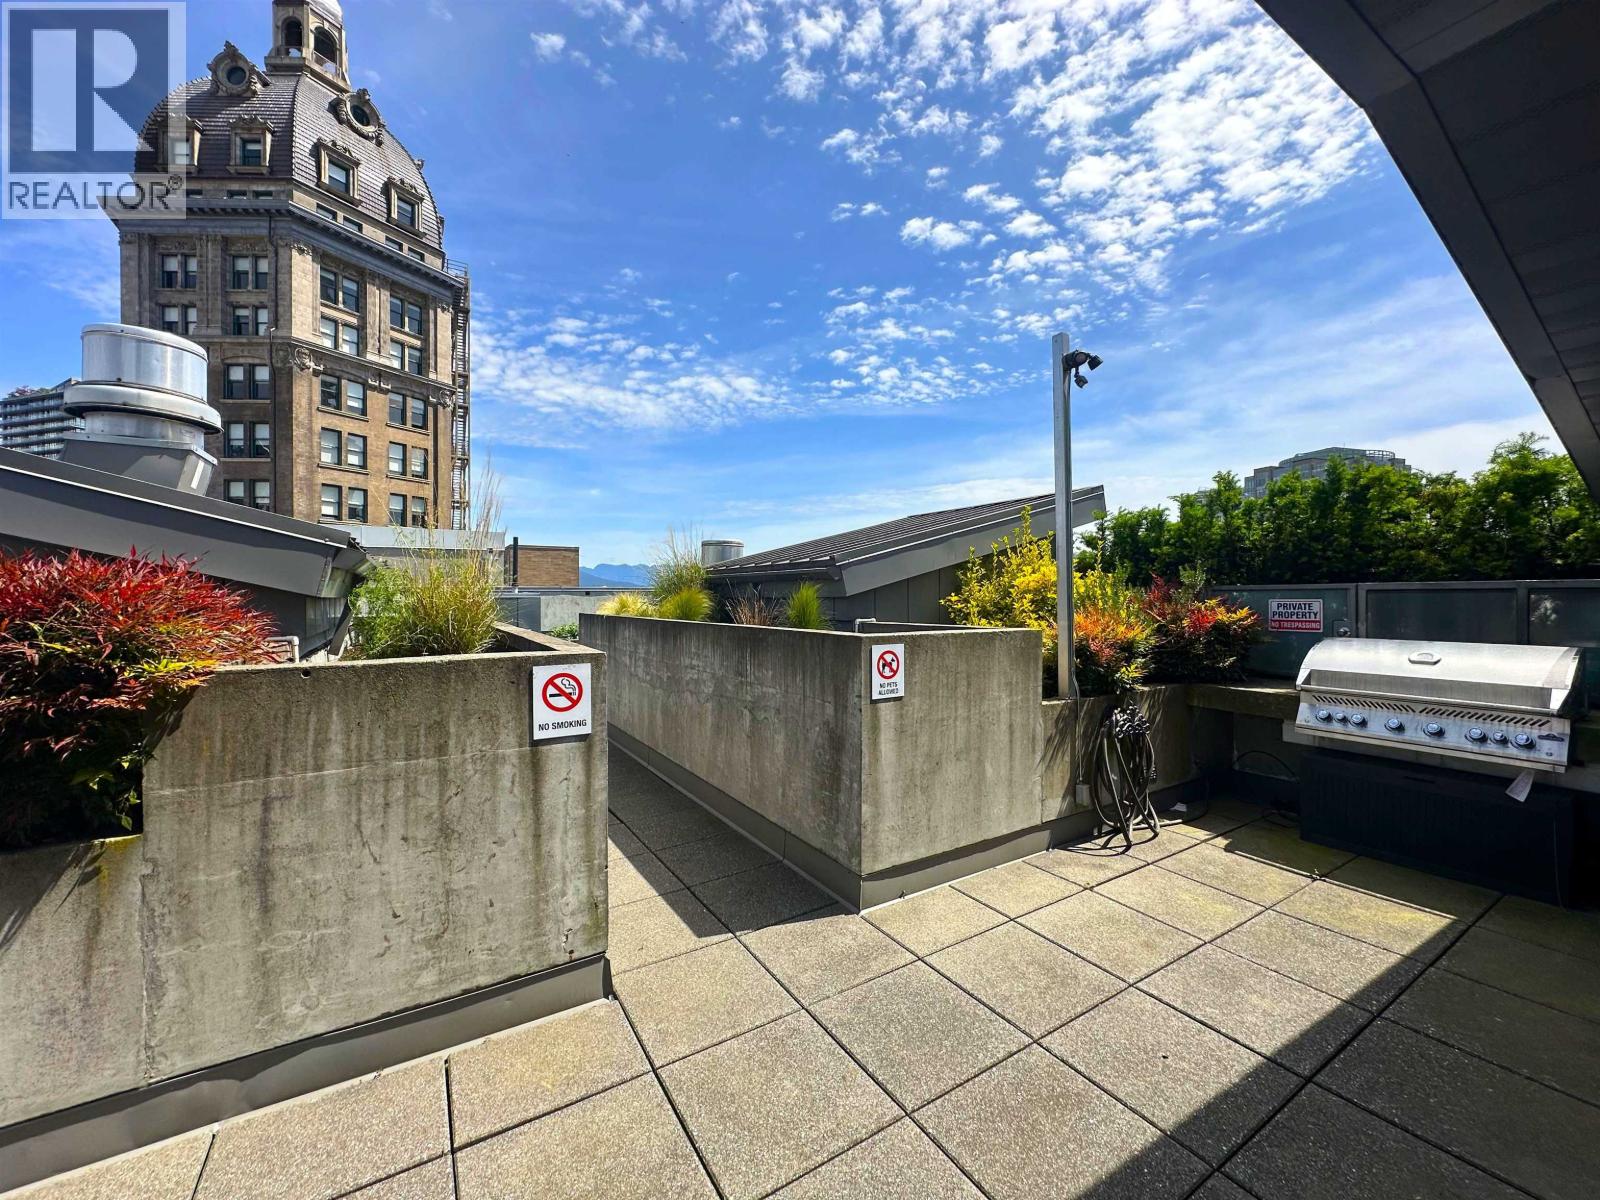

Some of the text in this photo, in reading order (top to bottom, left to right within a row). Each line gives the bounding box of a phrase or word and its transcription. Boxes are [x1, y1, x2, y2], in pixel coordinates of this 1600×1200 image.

[1277, 602, 1313, 611] PRIVATE
[1272, 611, 1318, 619] PROPERTY
[1280, 621, 1320, 629] TRESPASSING
[538, 719, 587, 731] NO SMOKING
